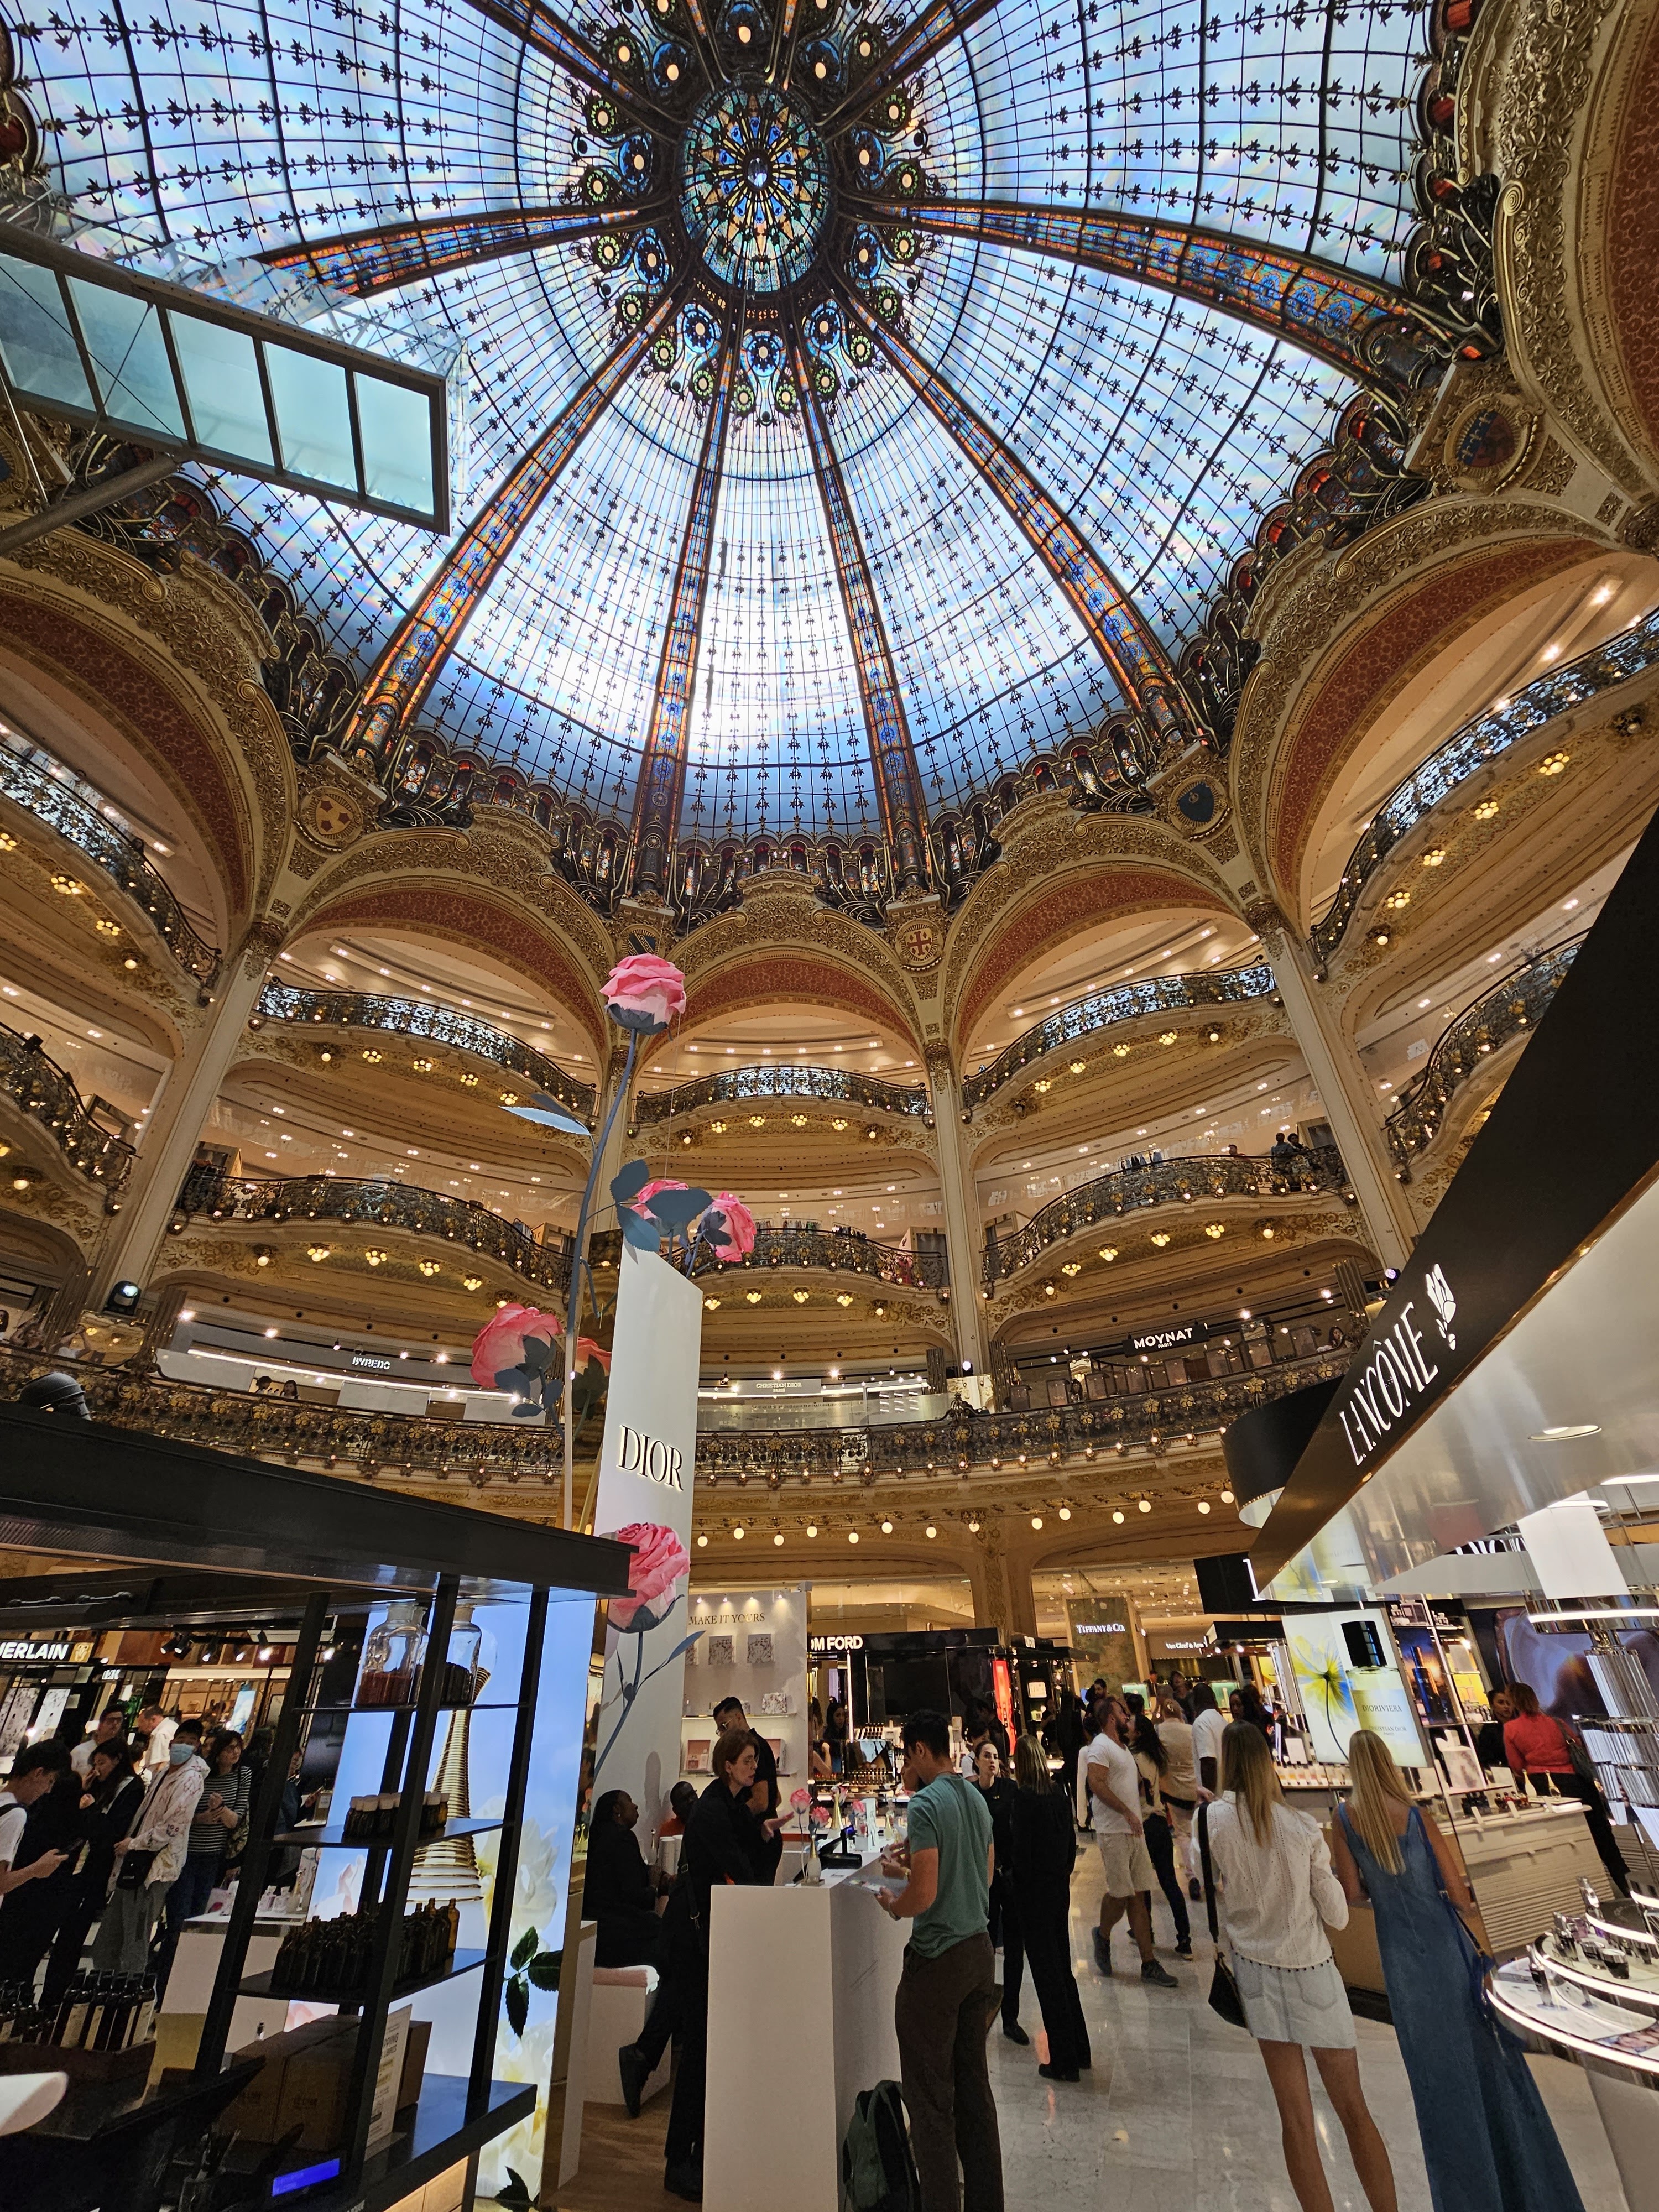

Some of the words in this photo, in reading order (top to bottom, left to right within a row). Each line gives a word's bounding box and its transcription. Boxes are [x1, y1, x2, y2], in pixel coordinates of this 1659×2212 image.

[1134, 1328, 1193, 1349] MOYNAT
[352, 1357, 390, 1370] BYREDO
[1339, 1301, 1438, 1466] LANCÔME
[616, 1425, 684, 1492] DIOR
[688, 1615, 717, 1625] MAKE
[719, 1614, 729, 1624] IT
[731, 1613, 765, 1623] YOURS
[827, 1635, 863, 1651] FORD
[1362, 1704, 1402, 1713] DIORIVIERA
